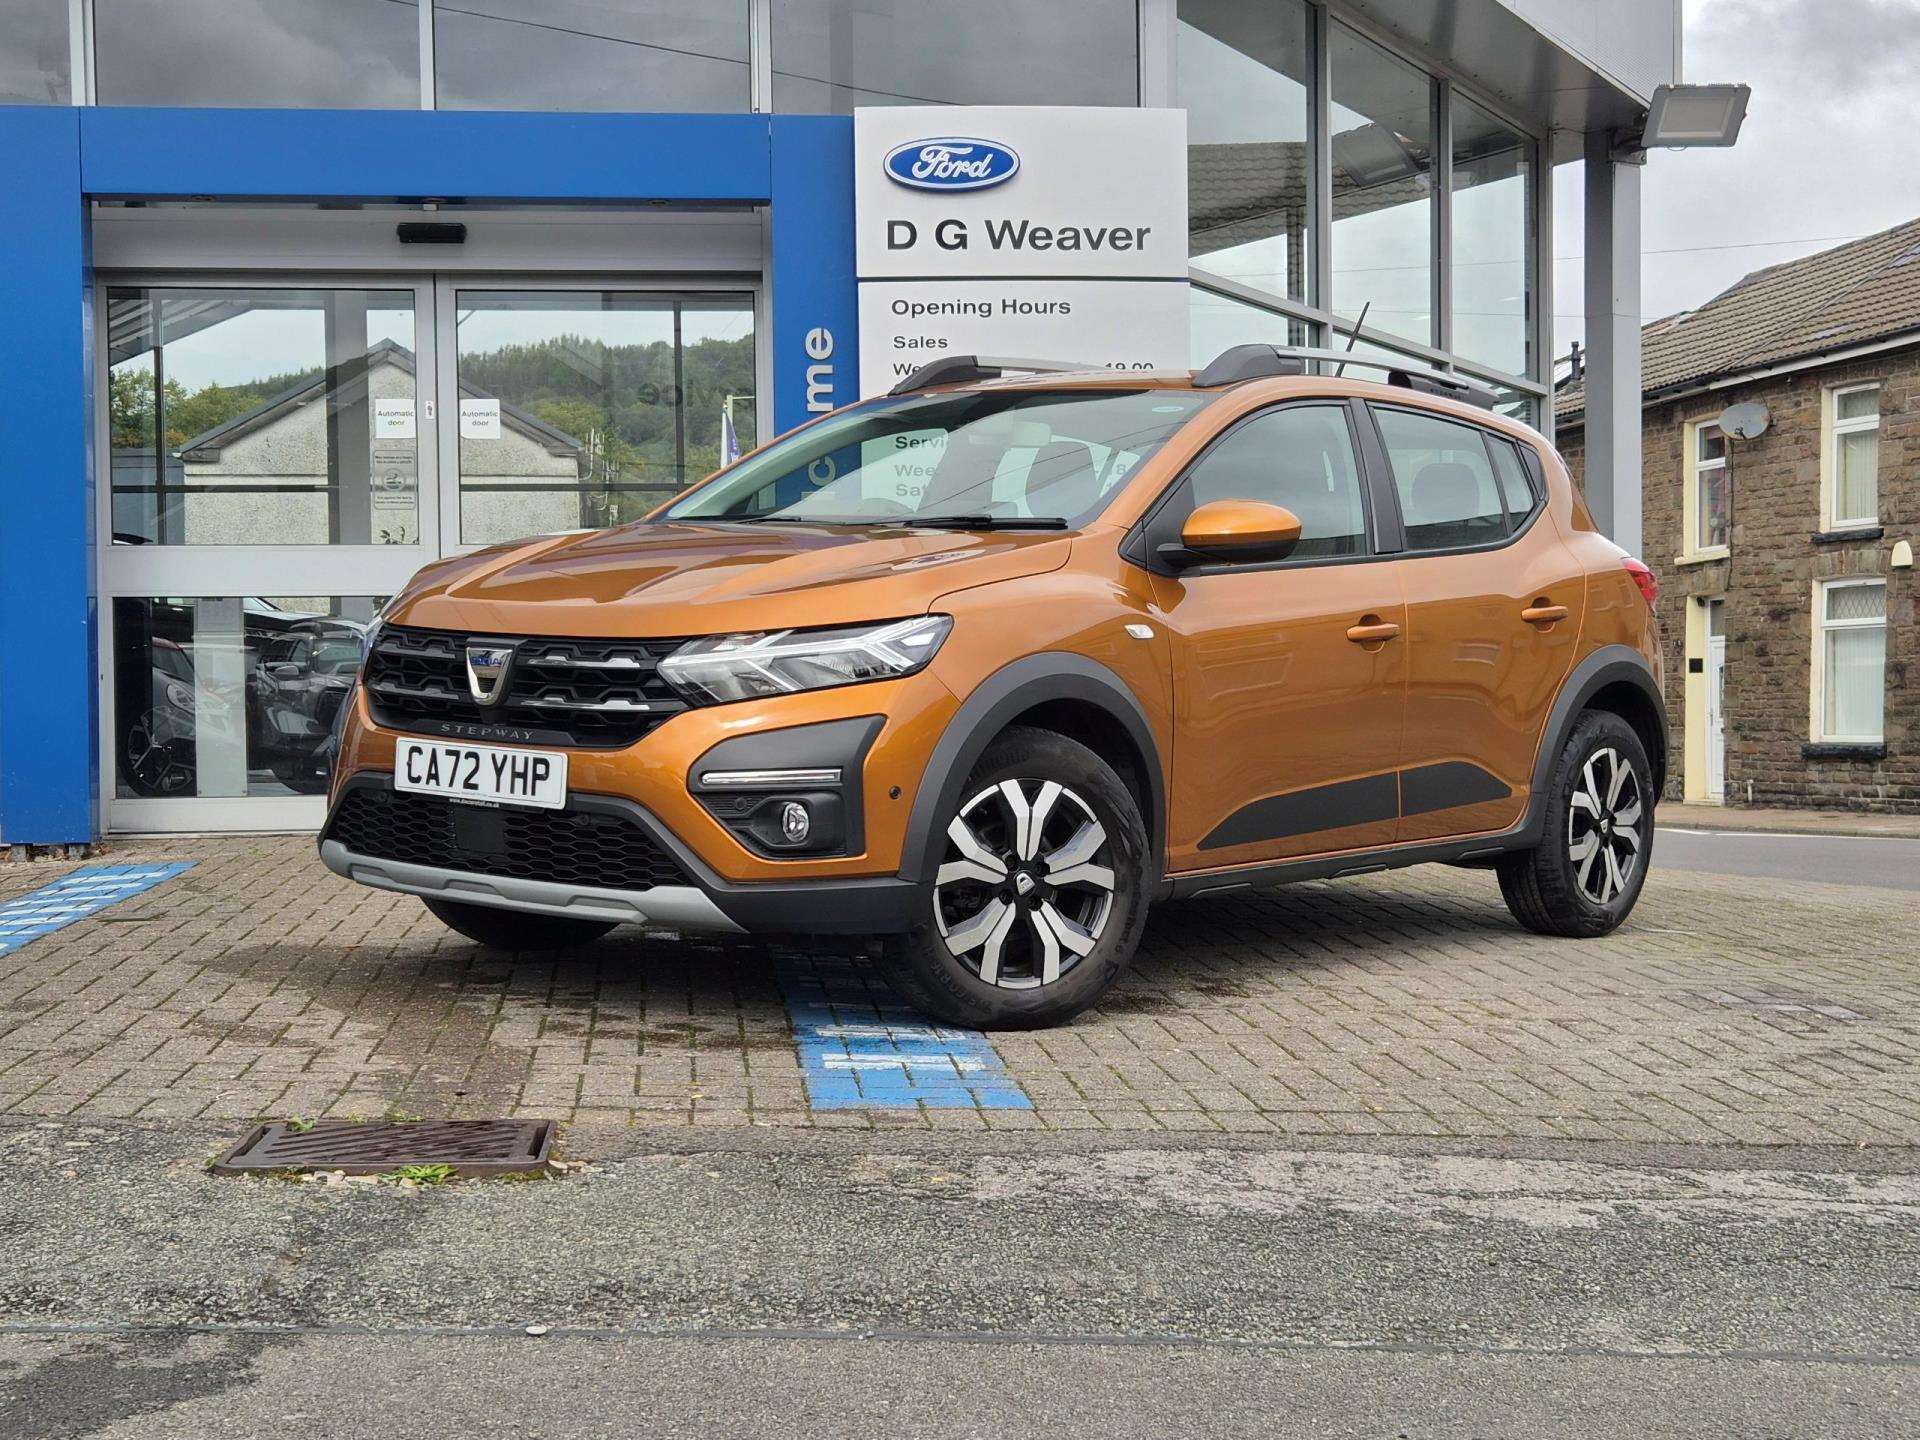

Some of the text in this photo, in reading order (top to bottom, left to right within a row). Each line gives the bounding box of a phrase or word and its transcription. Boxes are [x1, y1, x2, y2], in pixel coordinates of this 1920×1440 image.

[911, 144, 993, 179] Ford
[887, 219, 1152, 251] D G Weaver
[891, 299, 1071, 318] Opening Hours
[893, 335, 948, 349] Sales
[441, 724, 534, 740] STEPWAY
[407, 745, 550, 797] CA72 YHP
